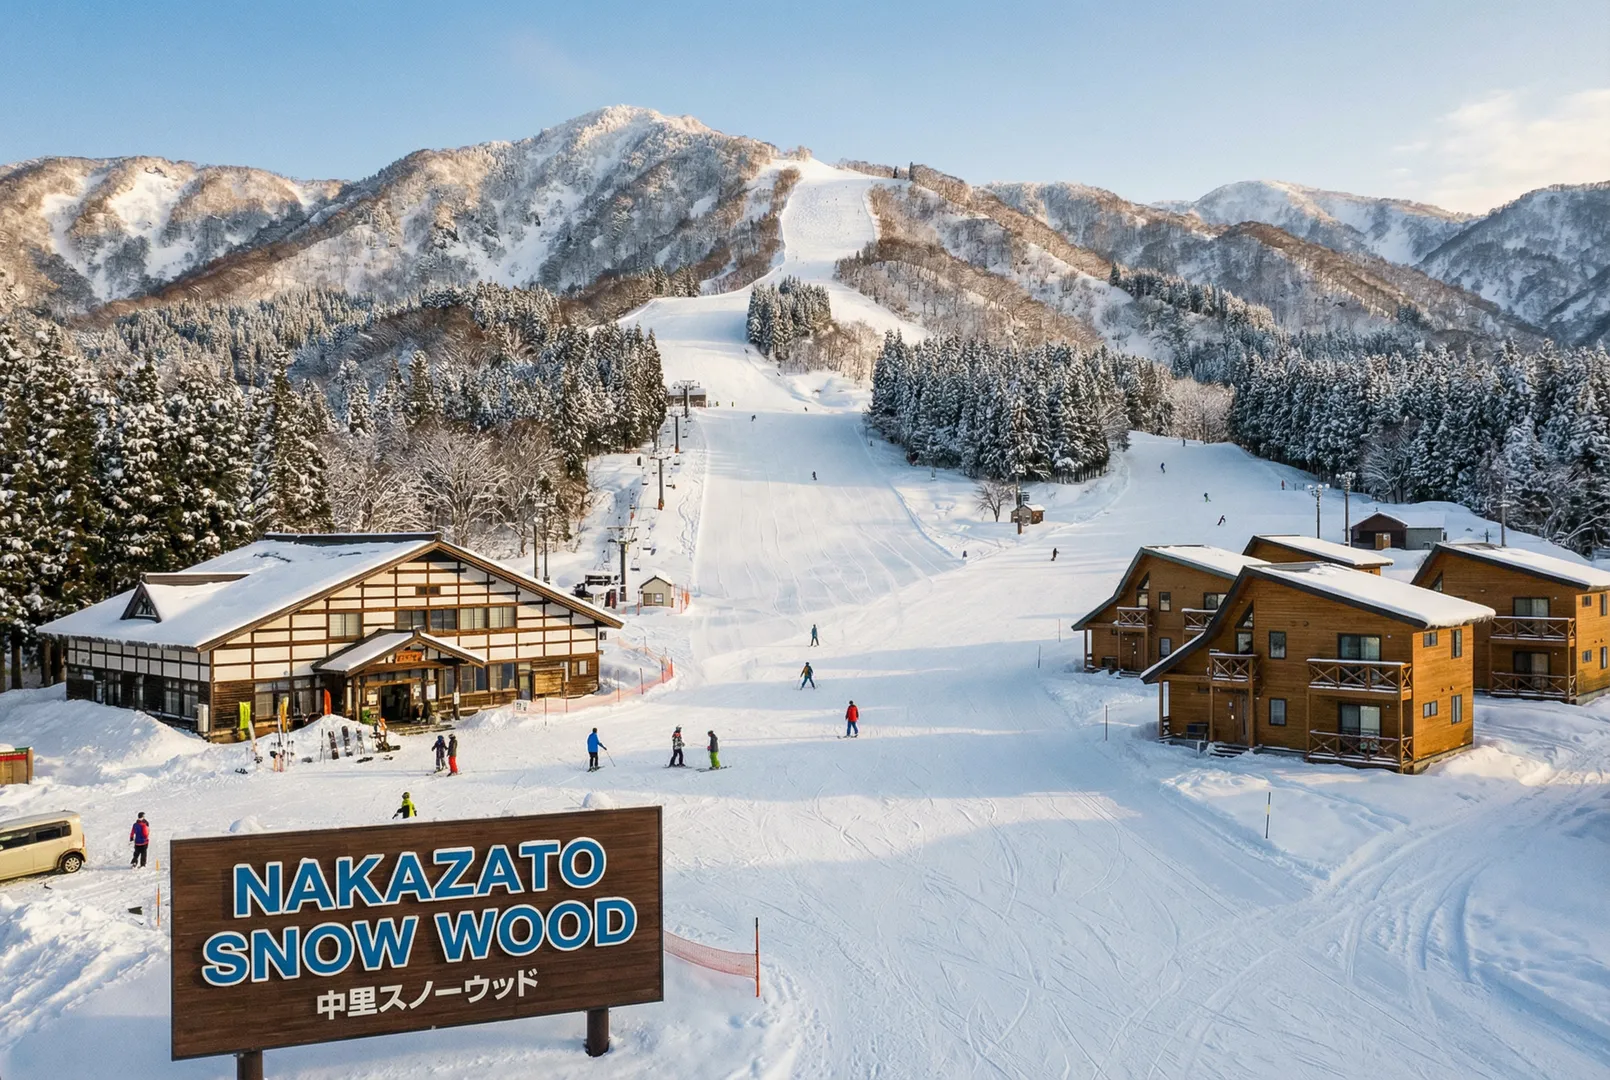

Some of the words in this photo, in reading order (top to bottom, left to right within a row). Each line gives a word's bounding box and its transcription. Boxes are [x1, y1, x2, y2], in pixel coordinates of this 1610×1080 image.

[233, 836, 607, 918] NAKAZATO
[201, 914, 419, 987] SNOW
[434, 897, 638, 963] WOOD
[316, 968, 538, 1020] 中里スノーウッド
